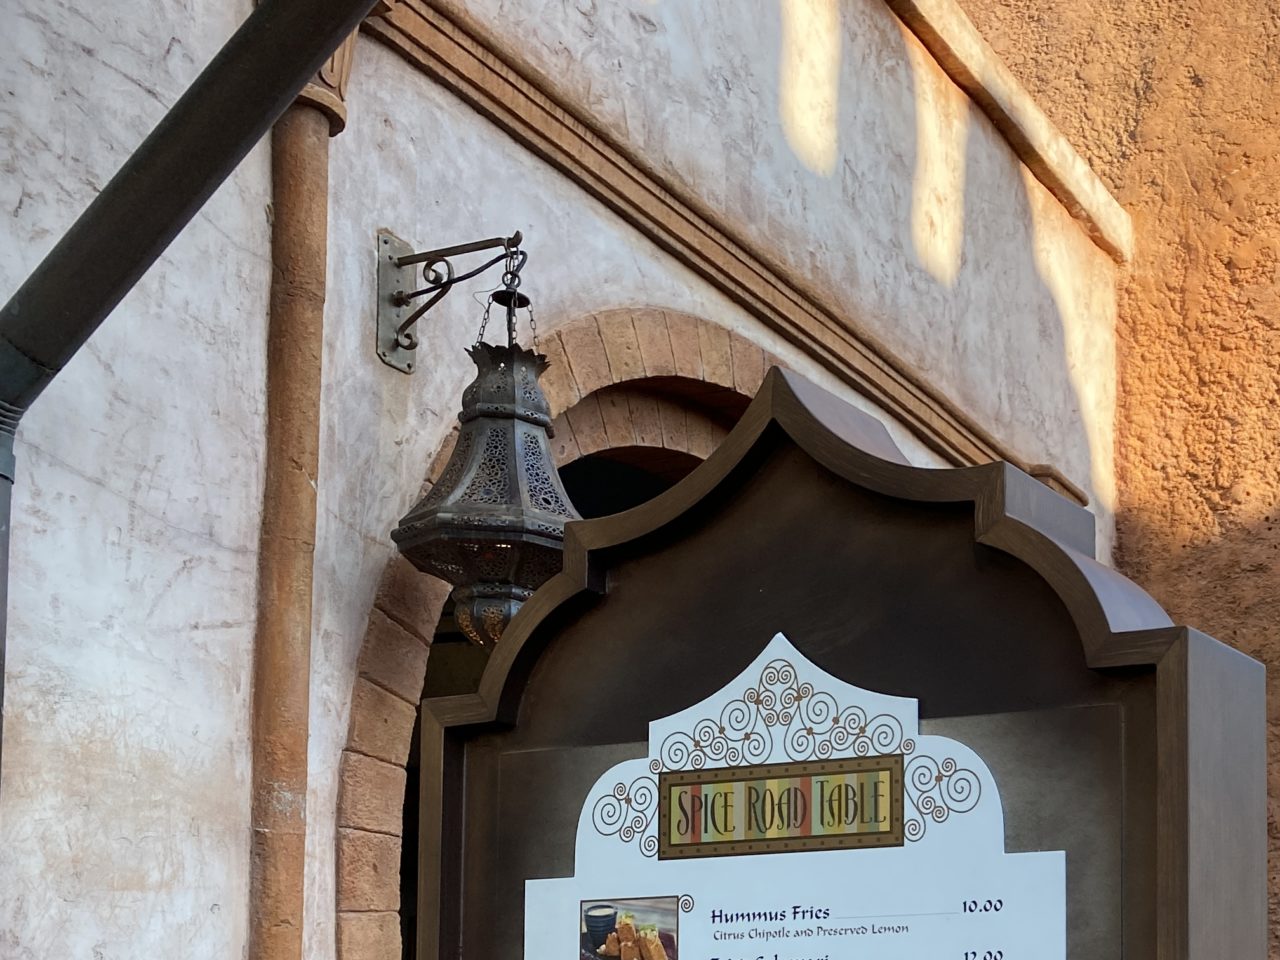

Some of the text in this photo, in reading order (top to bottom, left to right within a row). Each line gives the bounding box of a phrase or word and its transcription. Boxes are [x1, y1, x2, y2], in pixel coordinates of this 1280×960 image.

[677, 780, 887, 836] SPICE ROAD TABLE
[712, 899, 1003, 923] Hummus Fries 10.00
[714, 924, 908, 941] Citrus Chipotle and Preserved Lemon
